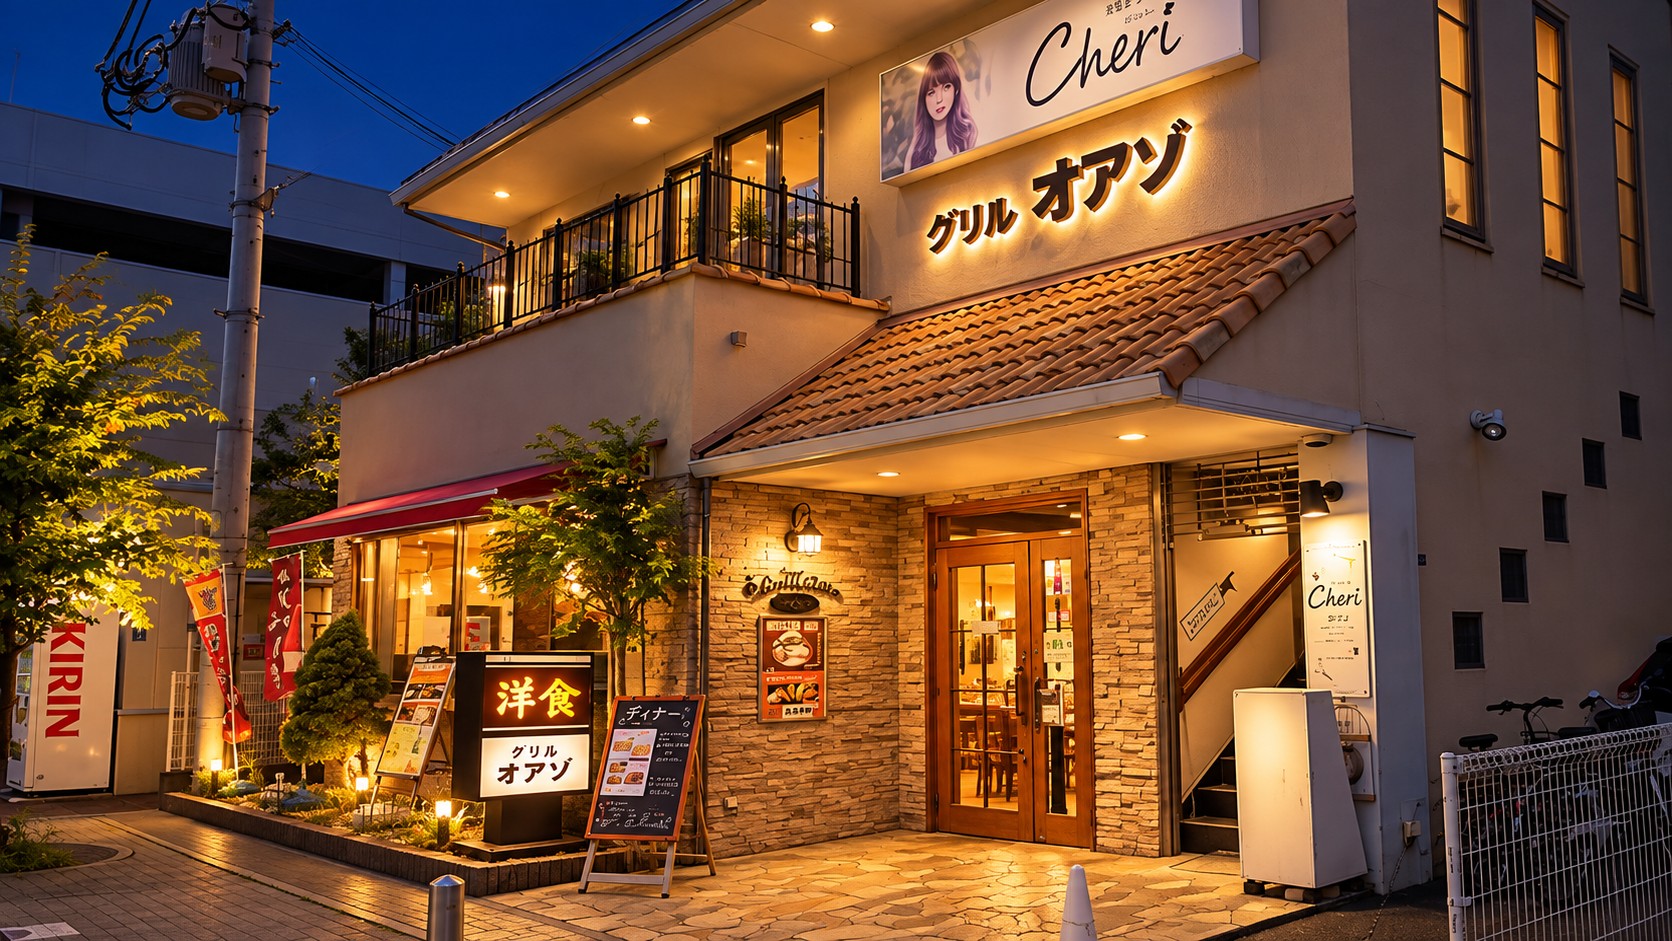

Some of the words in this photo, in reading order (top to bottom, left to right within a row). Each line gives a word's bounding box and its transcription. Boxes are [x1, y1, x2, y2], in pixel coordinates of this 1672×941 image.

[1025, 2, 1184, 107] Cheri
[927, 197, 1018, 254] グリル
[1032, 118, 1193, 223] オアゾ
[1308, 585, 1363, 609] Cheri
[45, 622, 86, 738] KIRIN
[496, 676, 581, 719] 洋食
[498, 757, 573, 785] オアゾ
[511, 744, 558, 758] グリル
